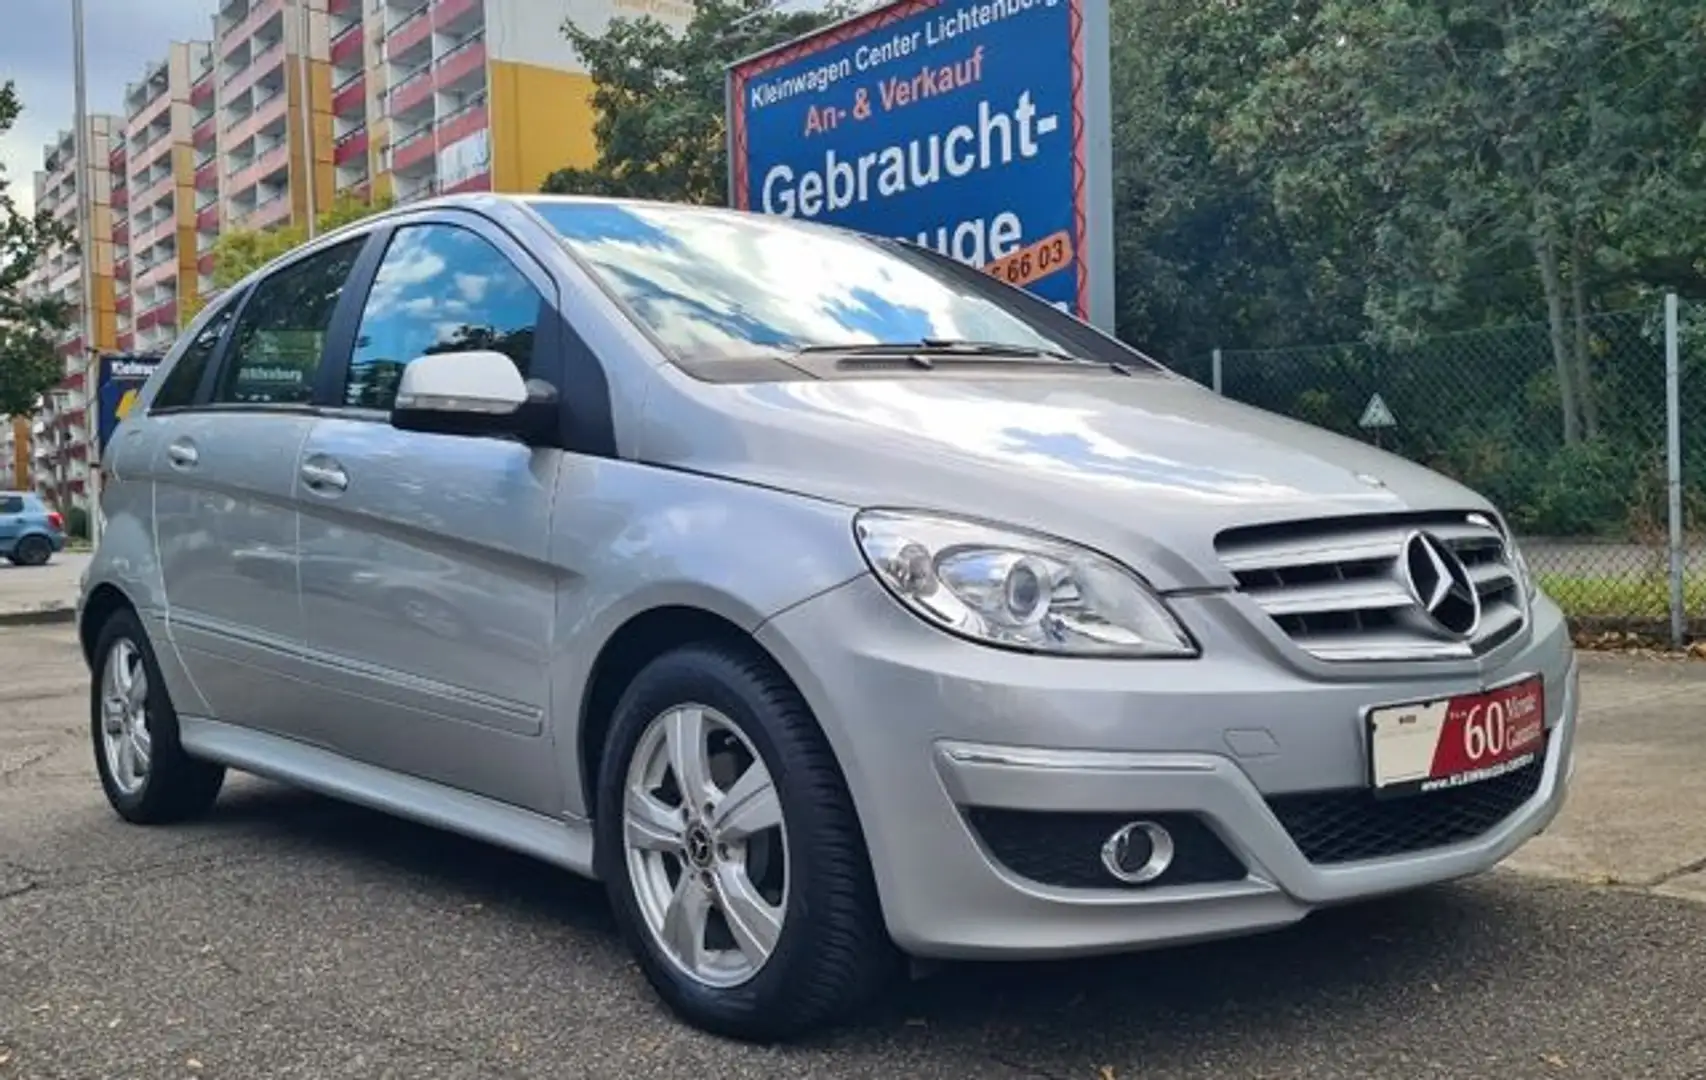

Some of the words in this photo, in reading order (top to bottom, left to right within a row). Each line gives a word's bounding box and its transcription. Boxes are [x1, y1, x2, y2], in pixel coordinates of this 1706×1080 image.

[751, 58, 850, 109] Kleinwagen
[855, 31, 921, 71] Center
[804, 104, 847, 137] An-
[853, 87, 872, 120] &
[878, 45, 985, 111] Verkauf
[762, 89, 1057, 218] Gebraucht-
[1007, 253, 1031, 282] 66
[1038, 239, 1063, 270] 03
[1464, 701, 1504, 760] 60
